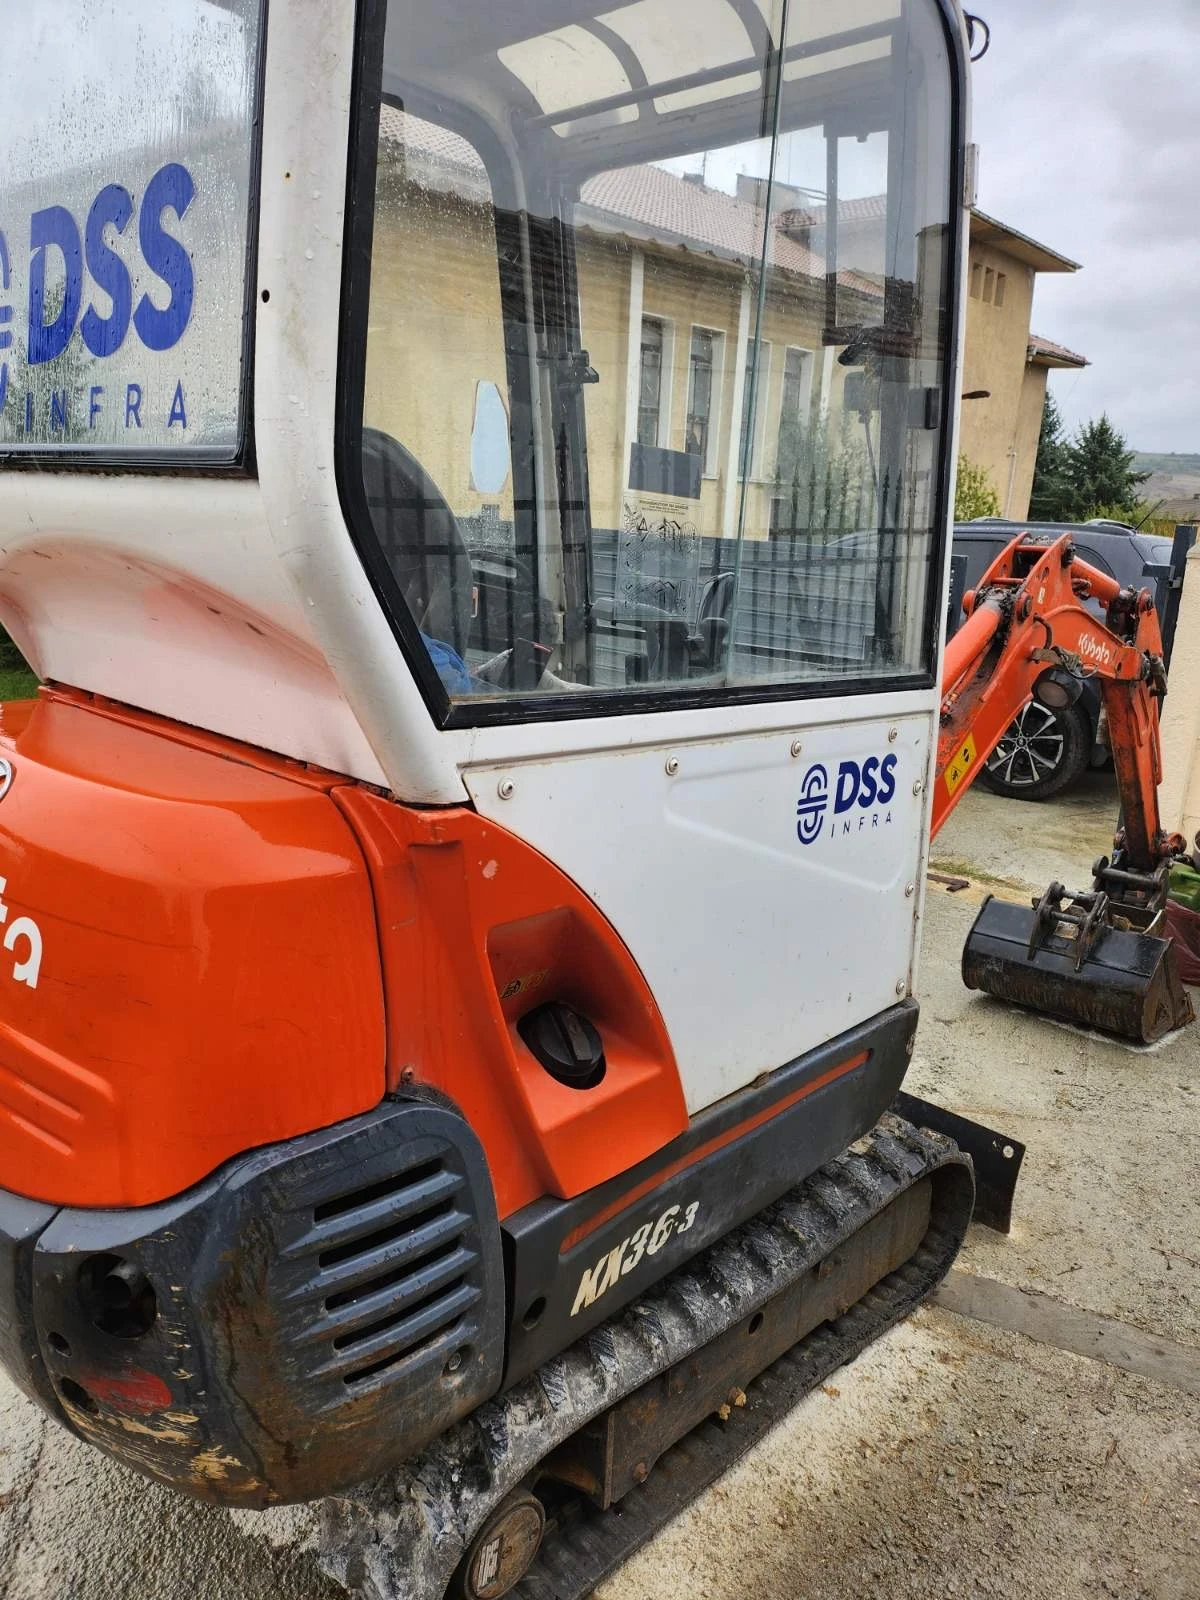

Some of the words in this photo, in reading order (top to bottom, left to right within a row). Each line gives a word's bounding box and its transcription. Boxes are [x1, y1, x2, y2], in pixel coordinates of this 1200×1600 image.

[27, 163, 195, 364] DSS
[25, 380, 187, 432] INFRA
[1079, 633, 1110, 664] Kubota
[834, 753, 897, 814] DSS
[830, 811, 892, 838] INFRA
